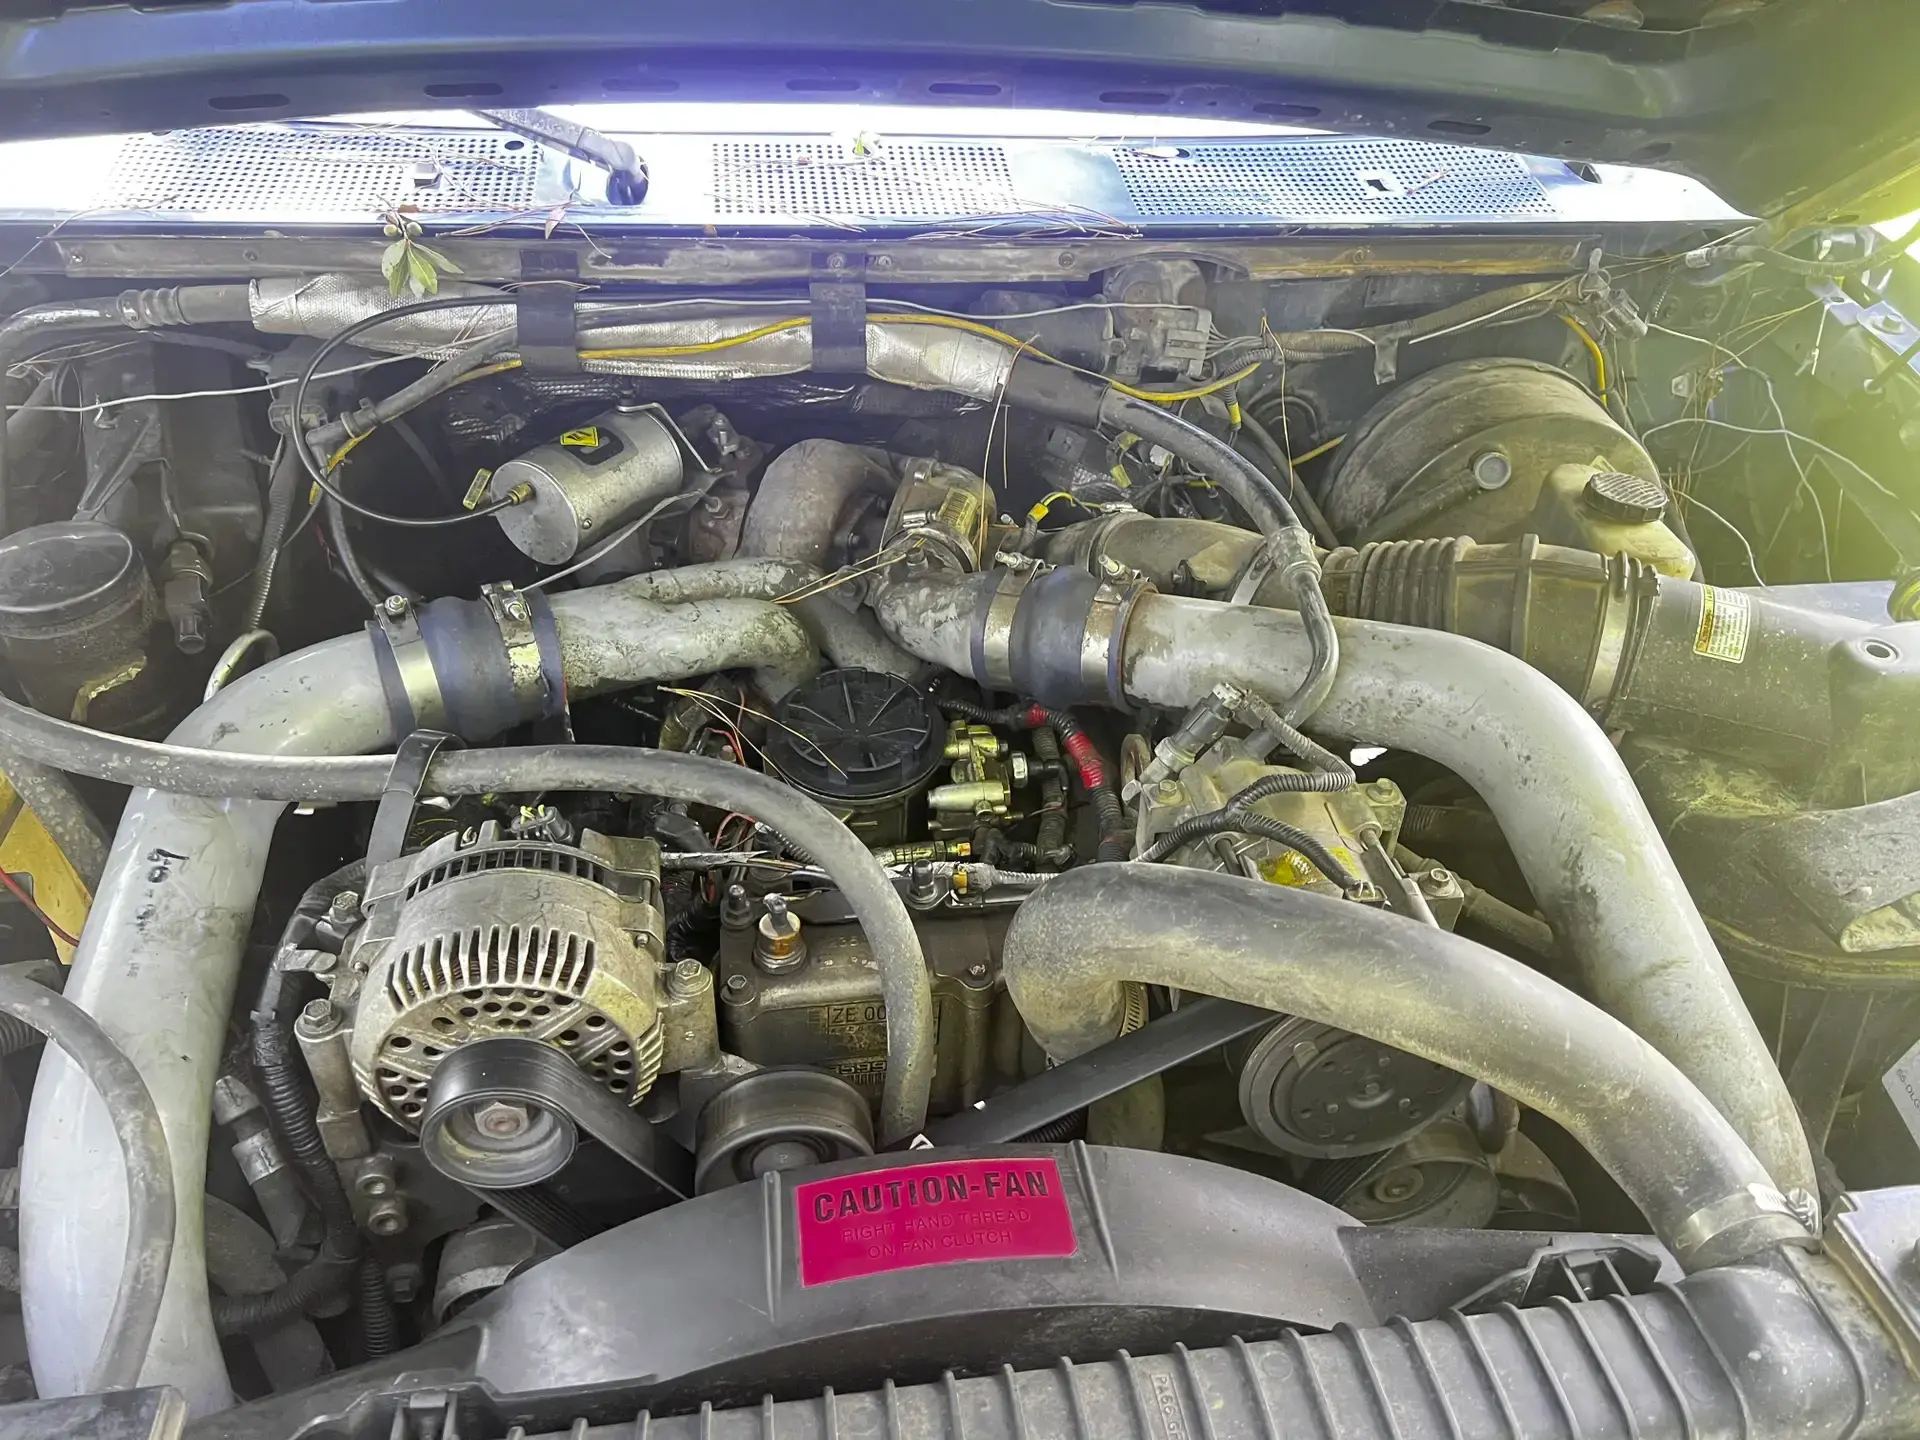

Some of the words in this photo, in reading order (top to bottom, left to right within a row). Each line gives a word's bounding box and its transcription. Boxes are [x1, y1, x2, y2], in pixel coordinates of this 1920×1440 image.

[832, 1007, 856, 1023] ZE
[814, 1170, 1049, 1222] CAUTION-FAN
[841, 1222, 896, 1242] RIGHT
[905, 1215, 954, 1231] HAND
[959, 1209, 1030, 1223] THREAD
[869, 1244, 895, 1259] ON
[901, 1237, 934, 1253] FAN
[941, 1230, 1012, 1247] CLUTCH
